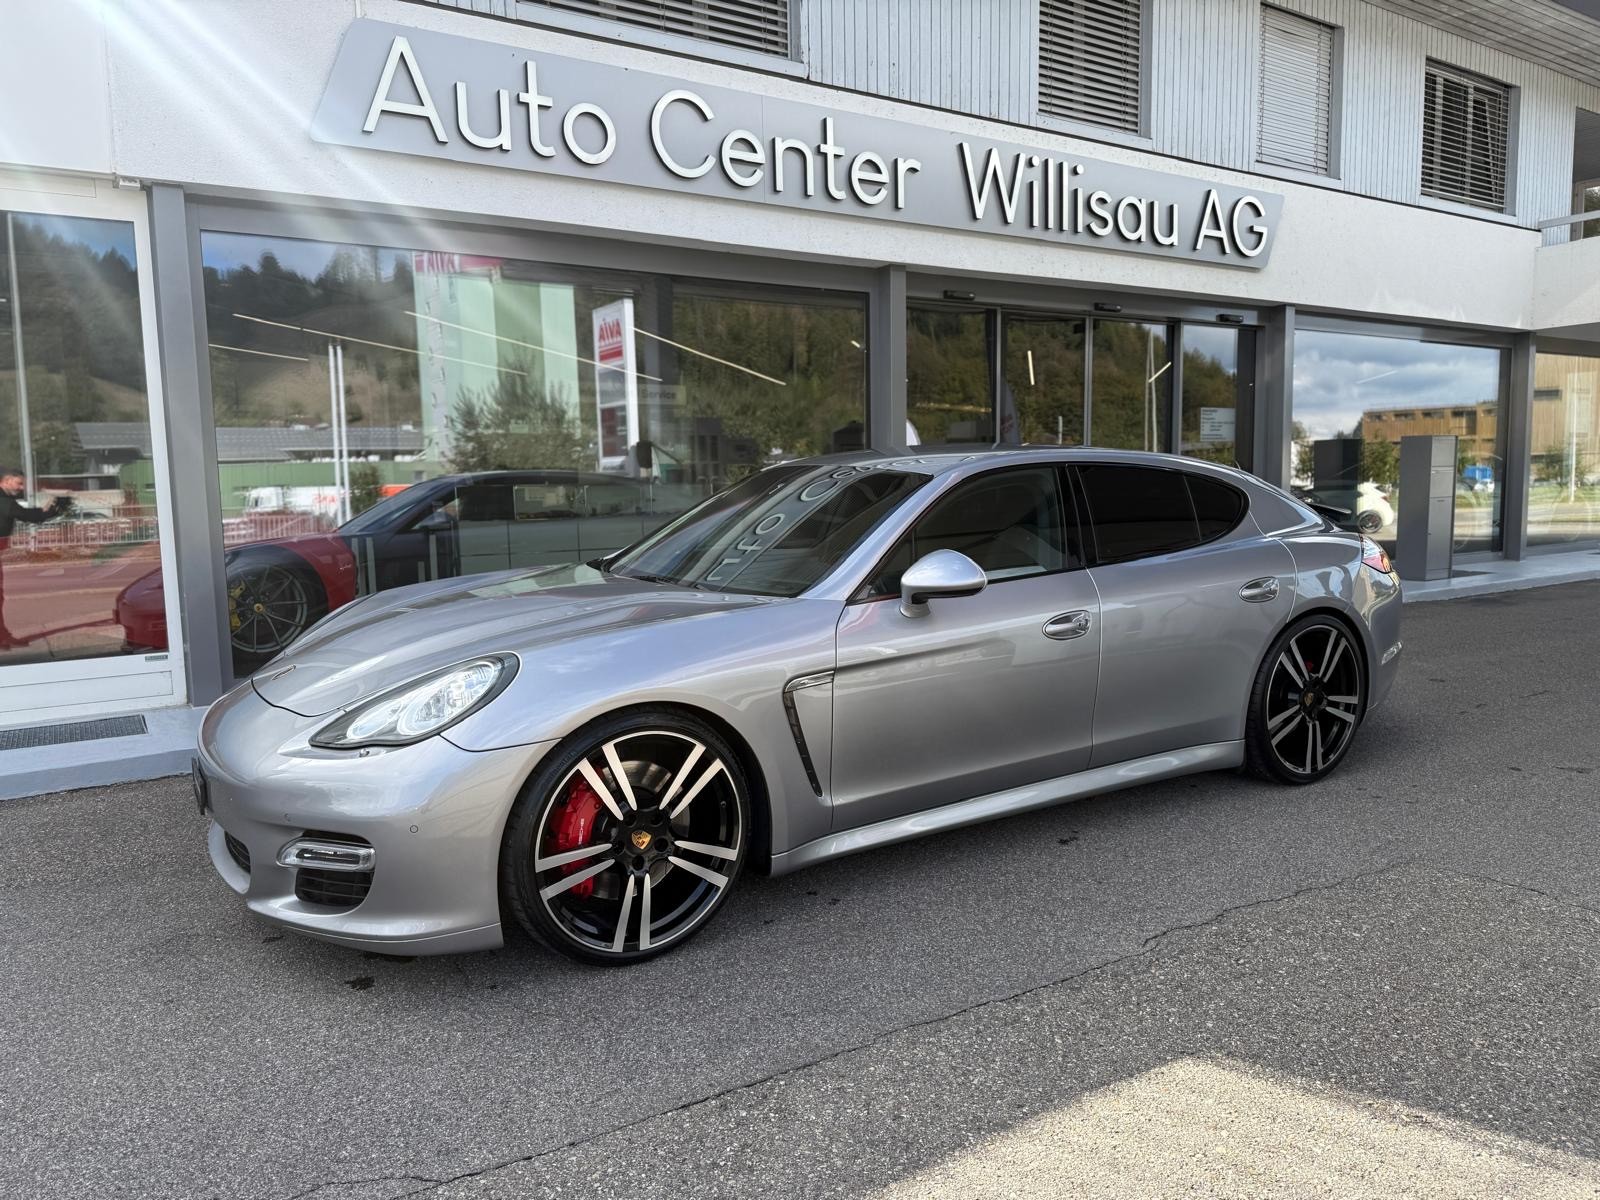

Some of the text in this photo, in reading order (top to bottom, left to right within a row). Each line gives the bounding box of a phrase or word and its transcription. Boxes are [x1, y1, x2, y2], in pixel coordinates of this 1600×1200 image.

[362, 35, 1269, 258] Auto Center Willisau AG
